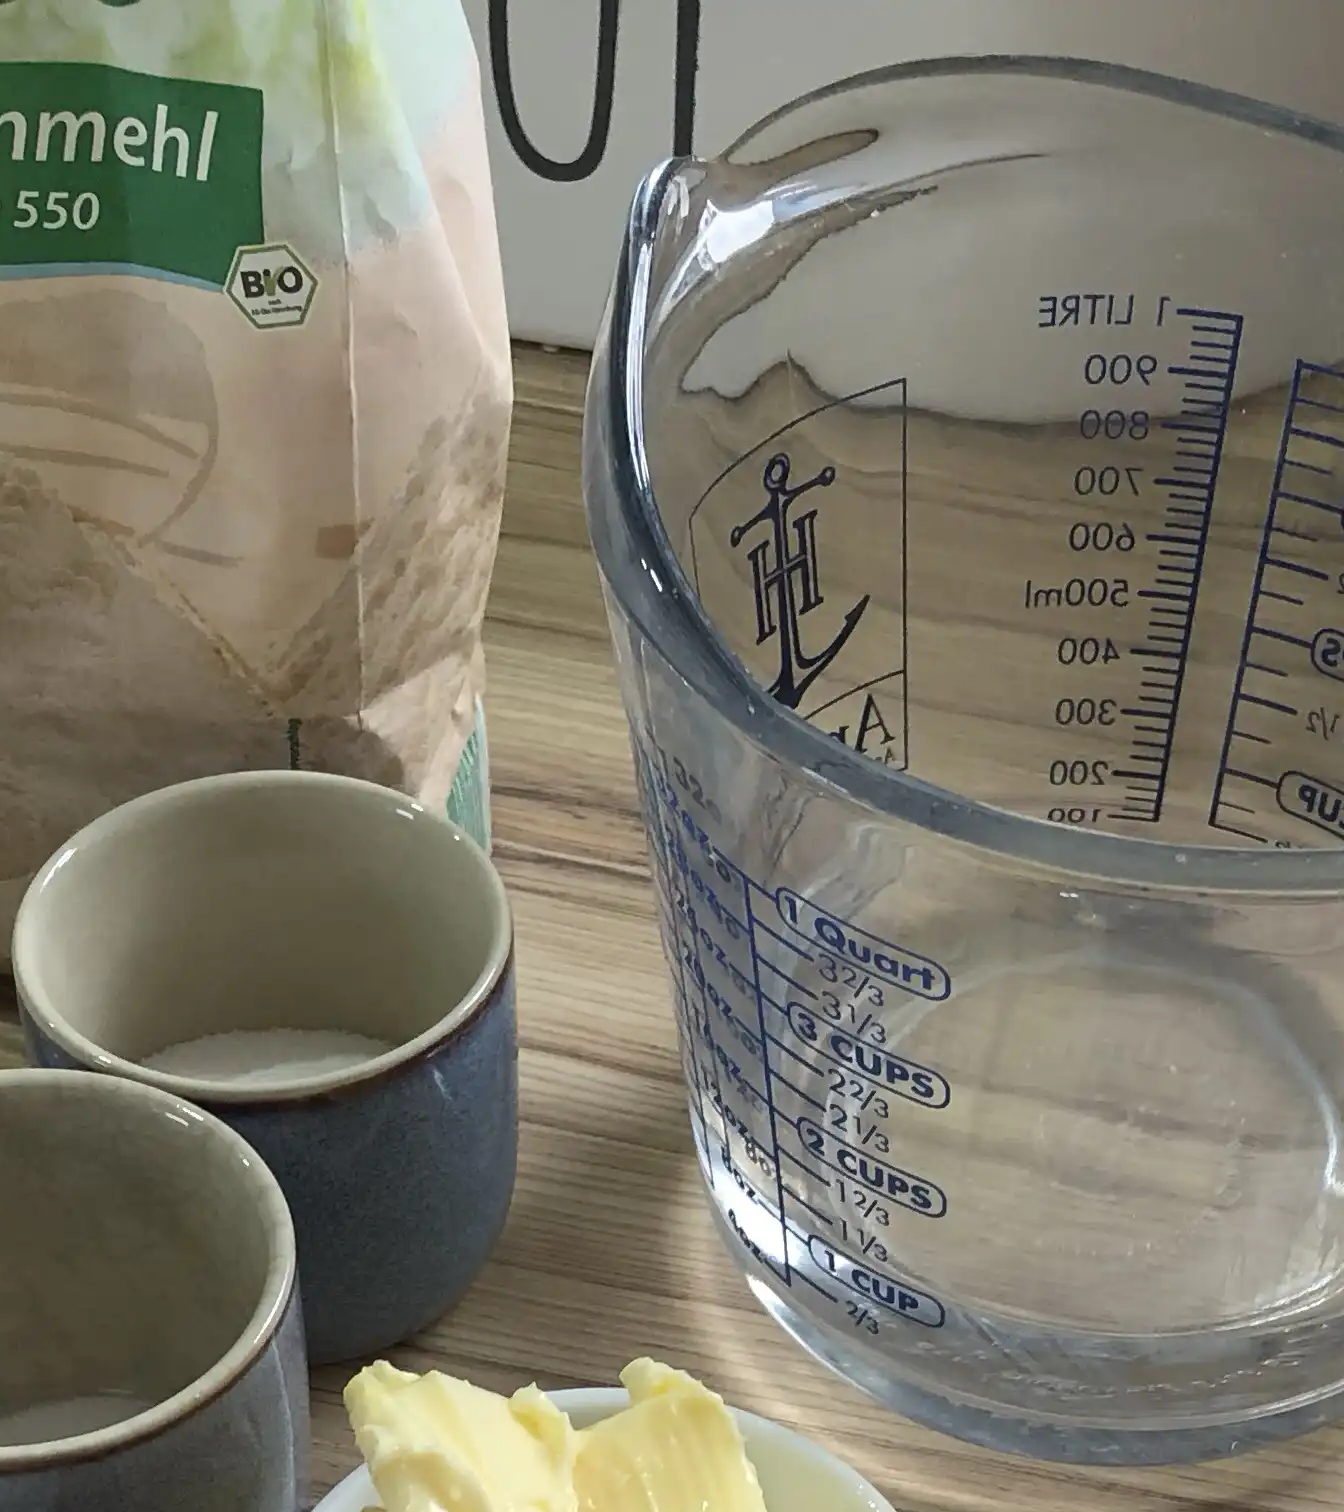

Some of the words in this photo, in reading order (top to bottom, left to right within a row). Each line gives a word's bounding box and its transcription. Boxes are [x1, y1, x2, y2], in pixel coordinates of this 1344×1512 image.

[13, 190, 100, 231] 550
[784, 896, 798, 925] 1
[814, 917, 935, 990] Quart
[797, 1012, 818, 1041] 3
[830, 1035, 935, 1098] CUPS
[807, 1128, 825, 1156] 2
[837, 1149, 933, 1209] CUPS
[824, 1250, 837, 1273] 1
[851, 1269, 919, 1310] CUP
[845, 1300, 879, 1335] 2/3
